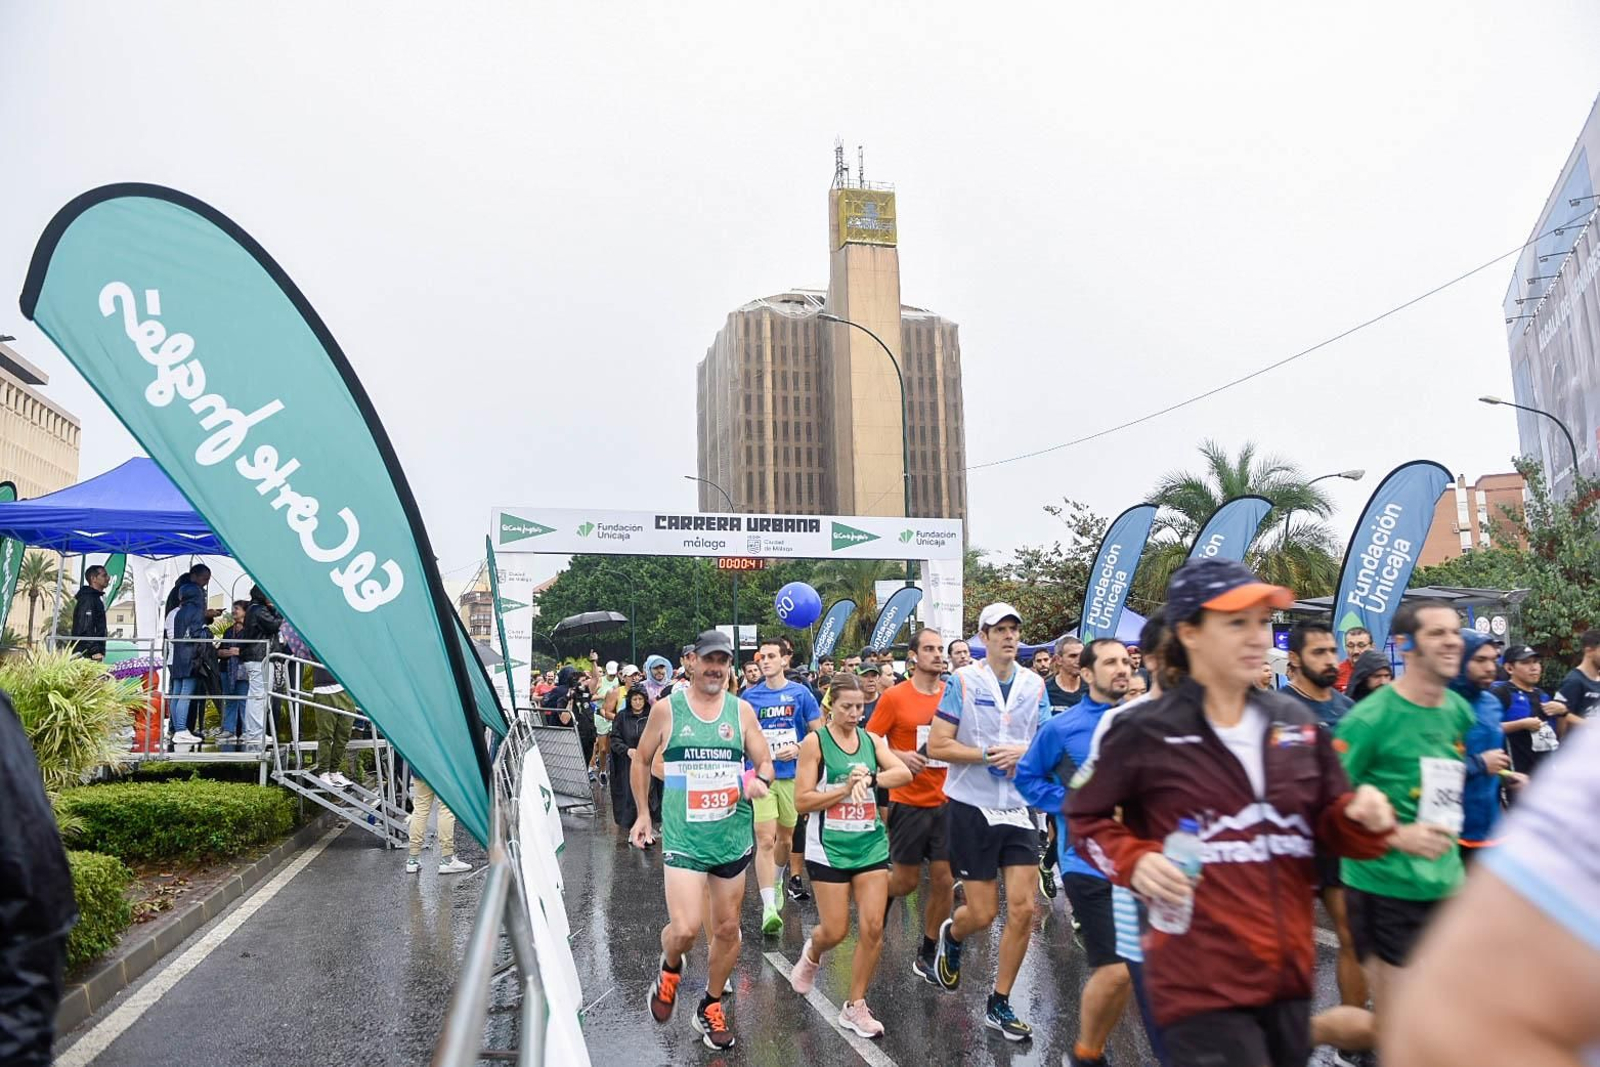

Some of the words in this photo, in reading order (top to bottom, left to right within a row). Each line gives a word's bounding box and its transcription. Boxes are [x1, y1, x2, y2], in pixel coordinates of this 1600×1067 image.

[597, 523, 643, 532] Fundación
[654, 515, 742, 532] CARRERA
[746, 517, 821, 533] URBANA
[597, 531, 631, 541] Unicaja
[916, 530, 957, 539] Fundación
[916, 538, 946, 548] Unicaja
[1347, 503, 1402, 608] Fundación
[718, 558, 764, 569] 00:00:41
[1365, 538, 1411, 614] Unicaja
[1086, 544, 1122, 626] Fundación
[1097, 571, 1127, 629] Unicaja
[874, 605, 898, 651] undación
[1477, 620, 1488, 632] 32
[1493, 619, 1505, 631] 35
[815, 616, 835, 656] undación
[877, 623, 896, 652] nicaja
[817, 631, 835, 657] nicaja
[760, 705, 793, 719] ROMA
[684, 748, 733, 760] ATLETISMO
[701, 792, 729, 808] 339
[838, 805, 866, 820] 129
